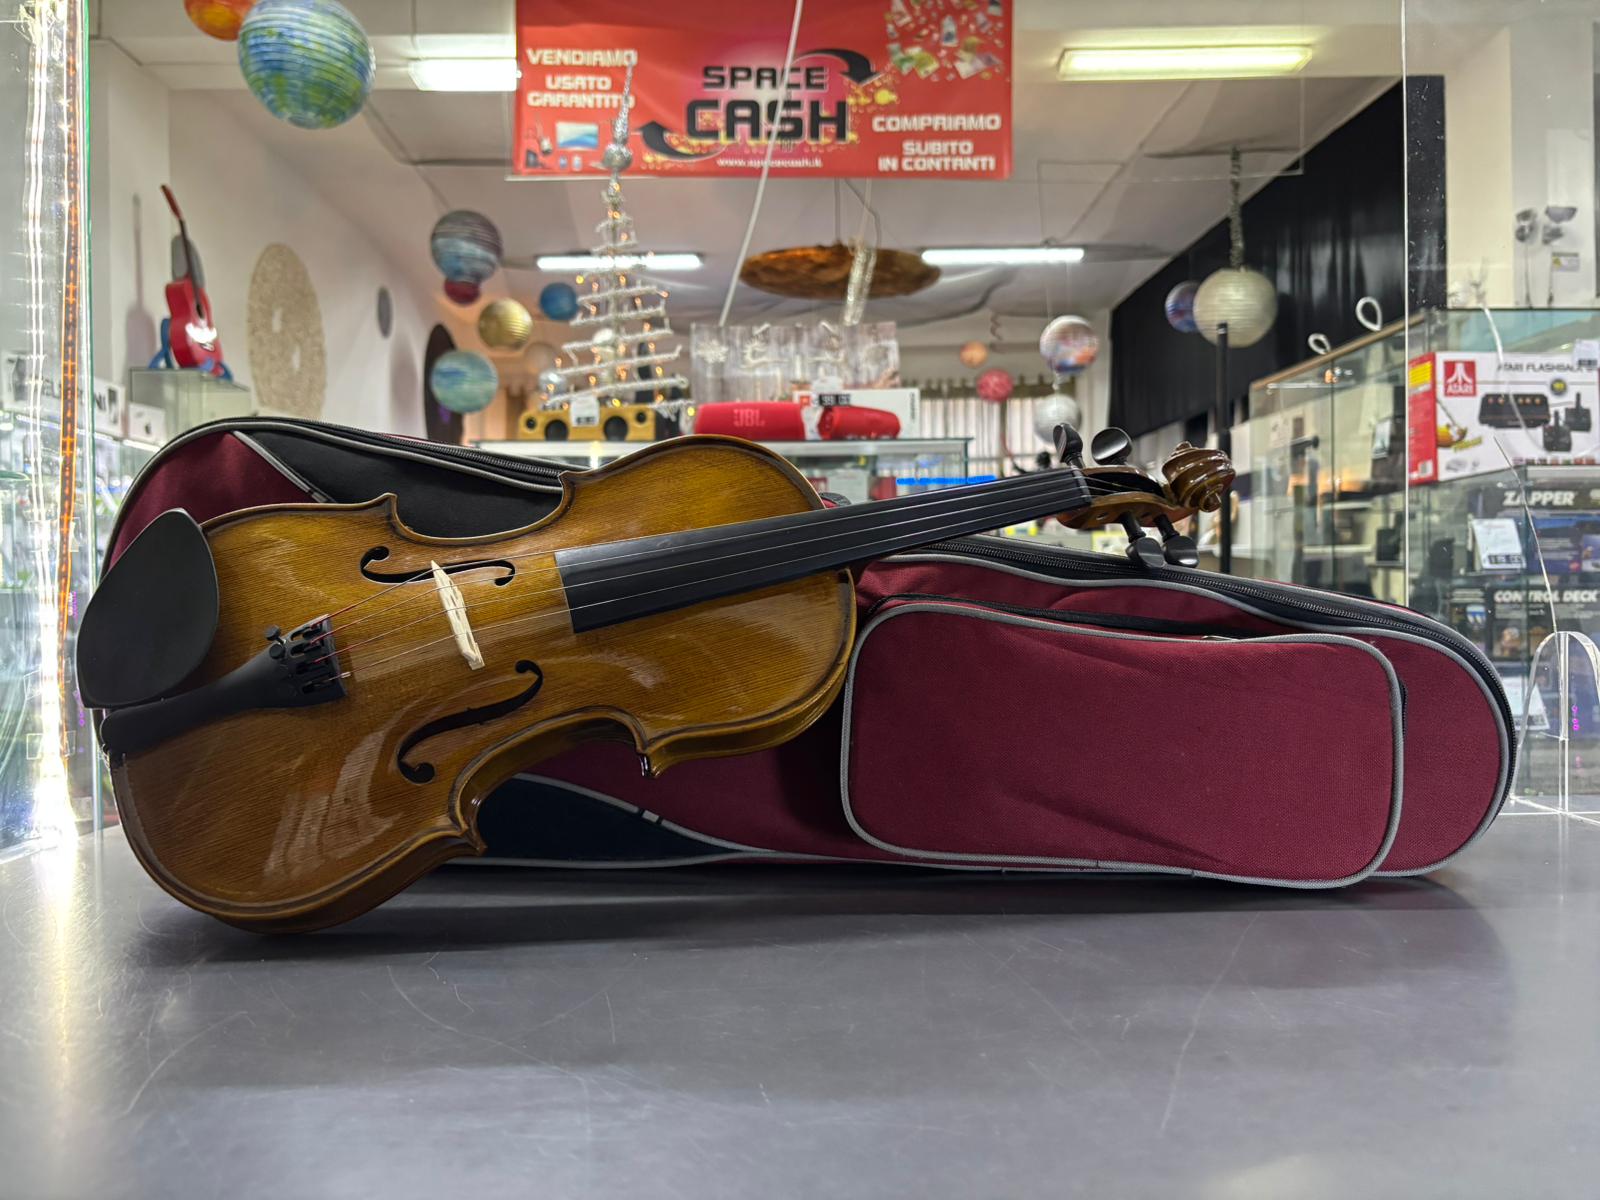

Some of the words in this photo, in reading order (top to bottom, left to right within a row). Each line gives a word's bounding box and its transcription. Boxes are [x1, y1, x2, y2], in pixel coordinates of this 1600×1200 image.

[526, 48, 638, 67] VENDIAMO
[545, 75, 612, 90] USATO
[703, 66, 826, 90] SPACE
[687, 99, 847, 141] CASH
[872, 114, 1002, 132] COMPRIAMO
[902, 140, 973, 155] SUBITO
[878, 156, 899, 171] IN
[902, 156, 996, 171] CONTANTI
[733, 408, 764, 427] JBL
[1494, 590, 1560, 603] CONTROL
[1562, 590, 1598, 603] DECK
